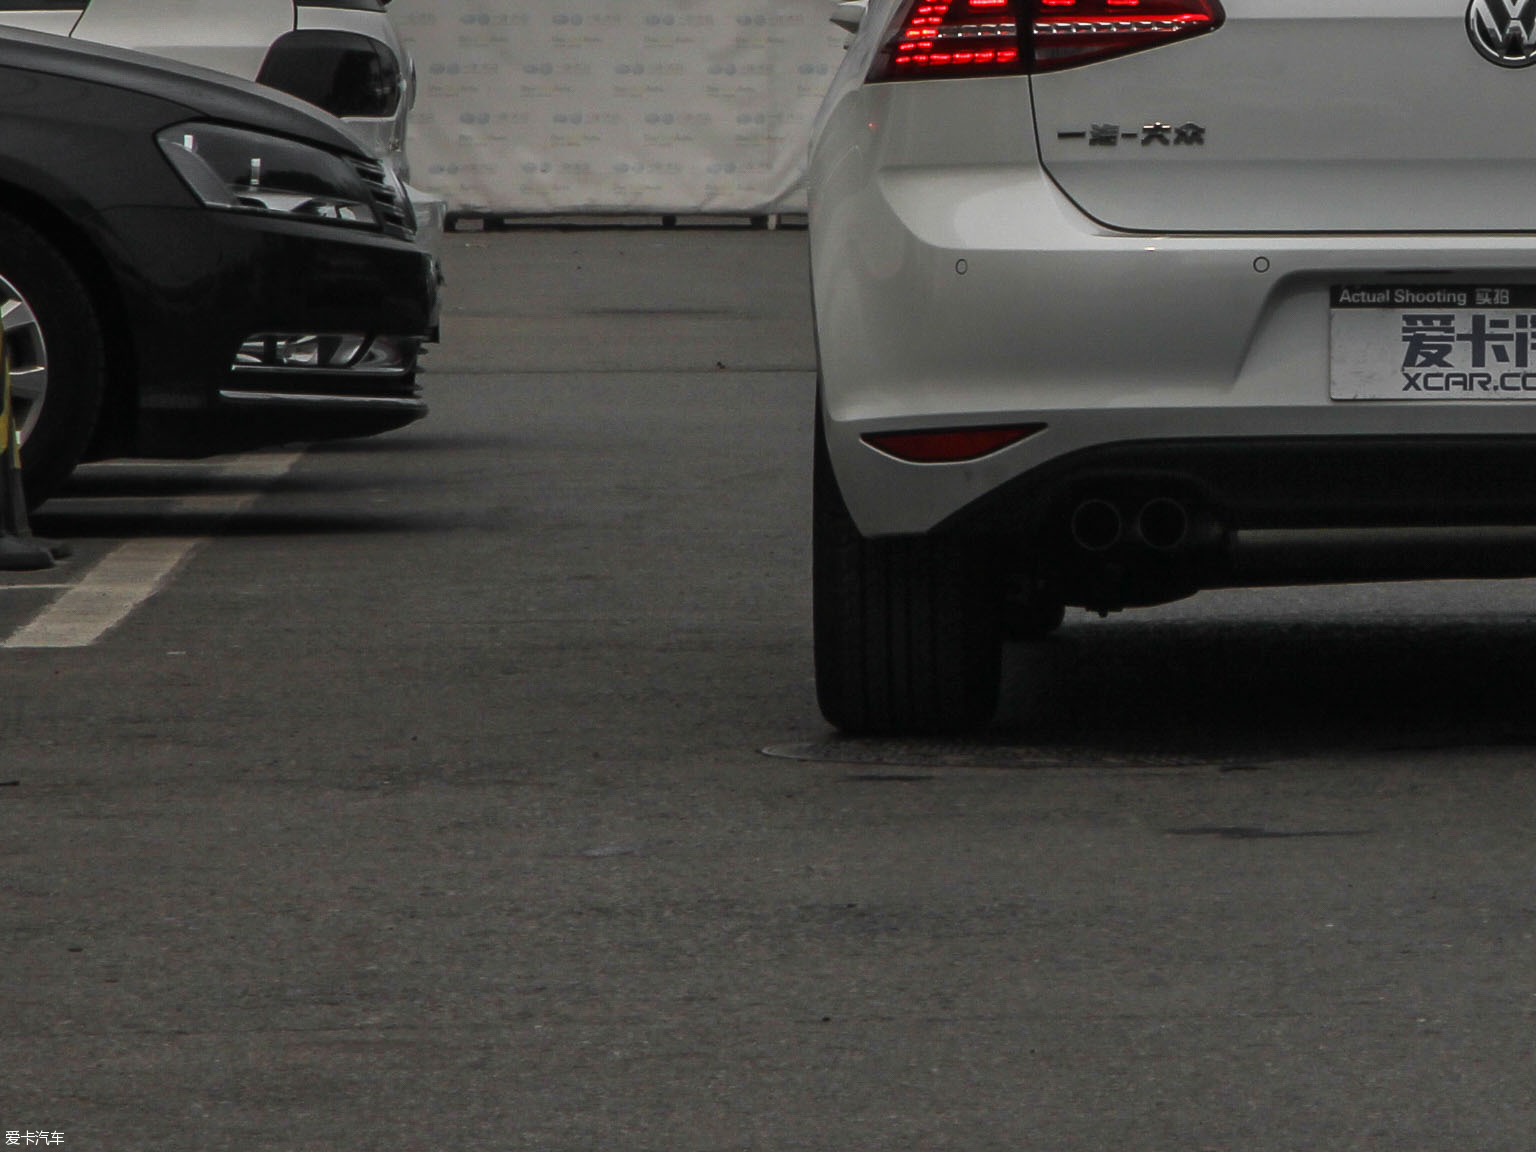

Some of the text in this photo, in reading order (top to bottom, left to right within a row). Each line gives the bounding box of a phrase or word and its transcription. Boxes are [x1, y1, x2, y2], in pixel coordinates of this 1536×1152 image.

[1057, 122, 1206, 146] 一汽-大众
[1340, 288, 1390, 304] Actual
[1394, 288, 1468, 306] Shooting
